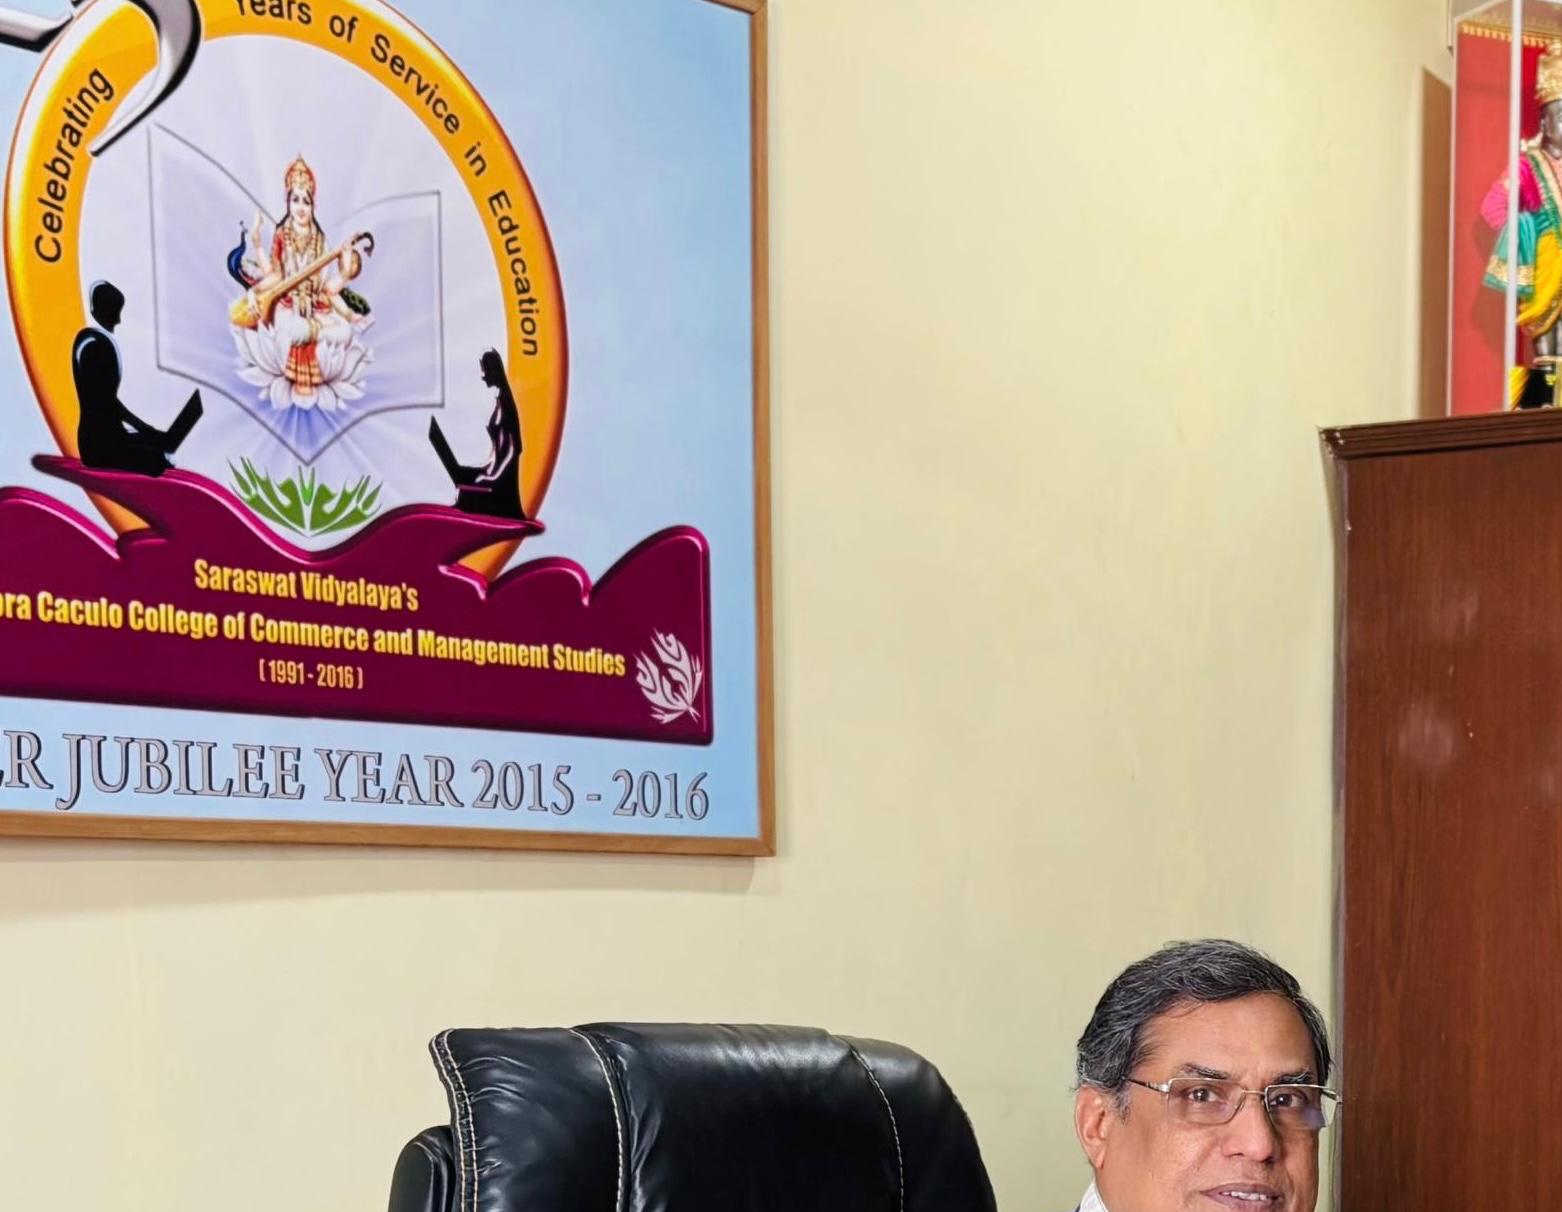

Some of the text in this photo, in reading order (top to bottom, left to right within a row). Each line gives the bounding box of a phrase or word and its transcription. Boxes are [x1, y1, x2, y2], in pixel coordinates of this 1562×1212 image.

[35, 68, 115, 263] Celebrating
[329, 16, 358, 42] of
[371, 33, 461, 134] Service
[464, 142, 488, 177] in
[488, 190, 539, 357] Education
[193, 557, 419, 611] Saraswat Vidyalaya's
[37, 590, 124, 629] Caculo
[128, 600, 218, 640] College
[223, 611, 246, 640] of
[249, 611, 369, 651] Commerce
[373, 628, 413, 655] and
[417, 629, 549, 669] Management
[552, 643, 626, 677] Studies
[55, 732, 306, 811] JUBILEE
[313, 747, 465, 808] YEAR
[470, 759, 575, 816] 2015
[611, 769, 711, 822] 2016
